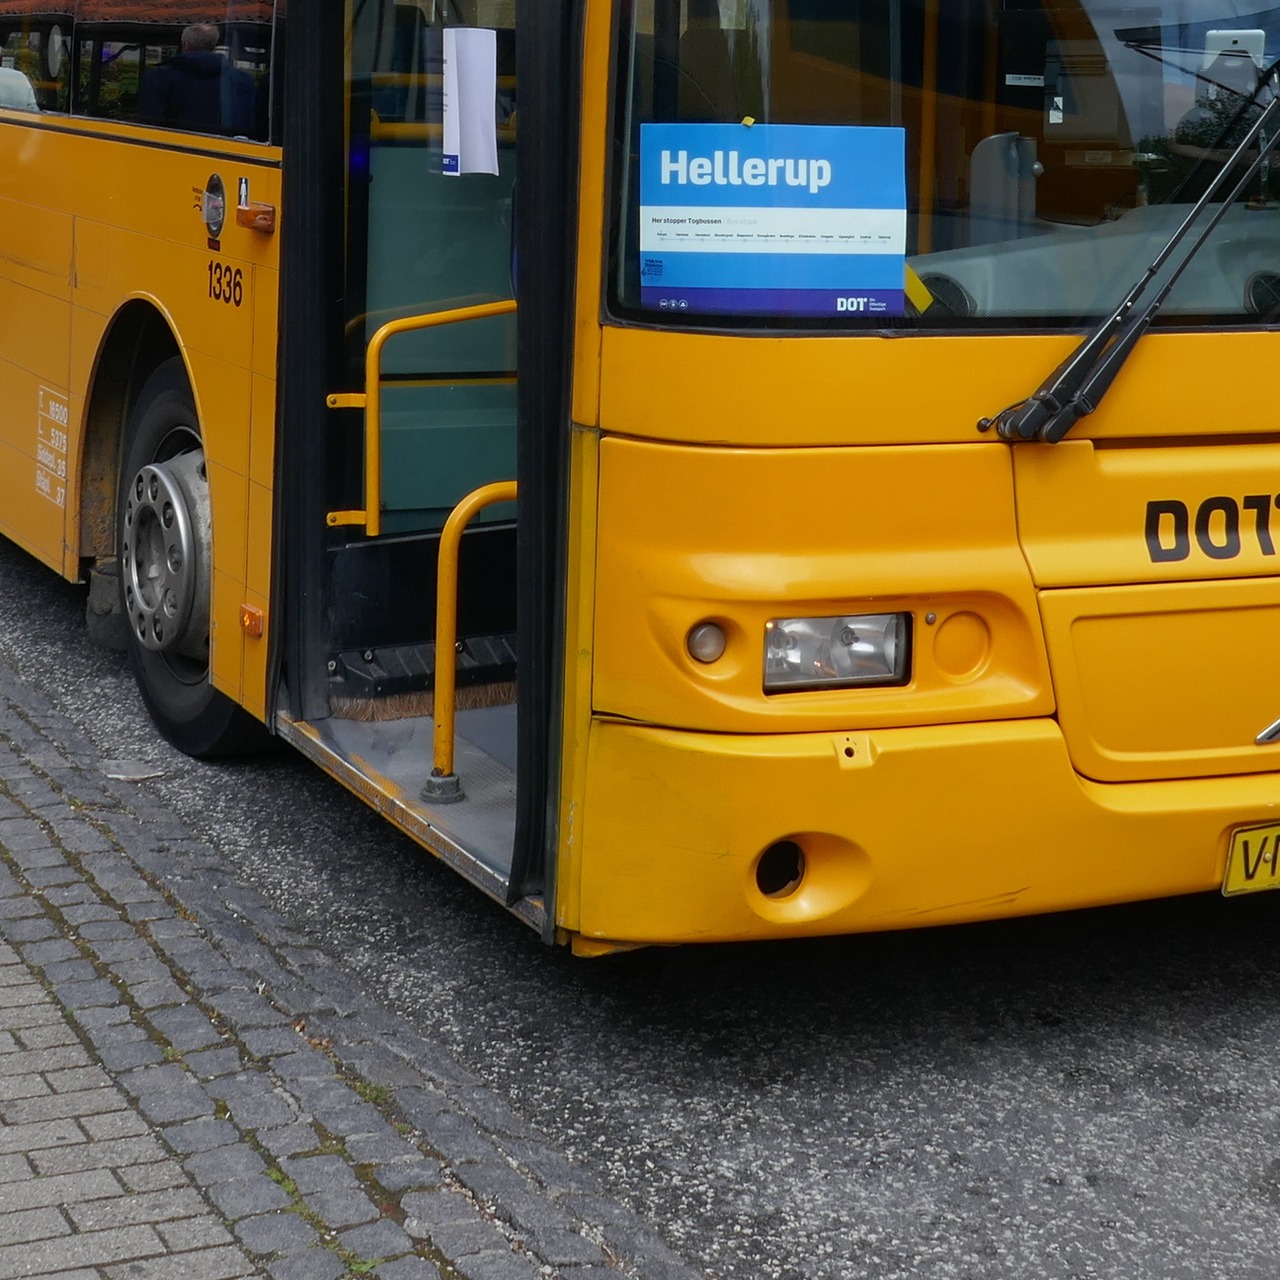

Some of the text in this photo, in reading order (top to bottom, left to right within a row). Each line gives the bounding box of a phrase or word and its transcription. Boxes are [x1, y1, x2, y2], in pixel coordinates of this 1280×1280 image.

[660, 150, 832, 194] Hellerup
[663, 217, 687, 225] stopper
[688, 217, 722, 225] Togbussen
[207, 260, 244, 308] 1336
[837, 297, 867, 311] DOT
[51, 428, 67, 451] 5375
